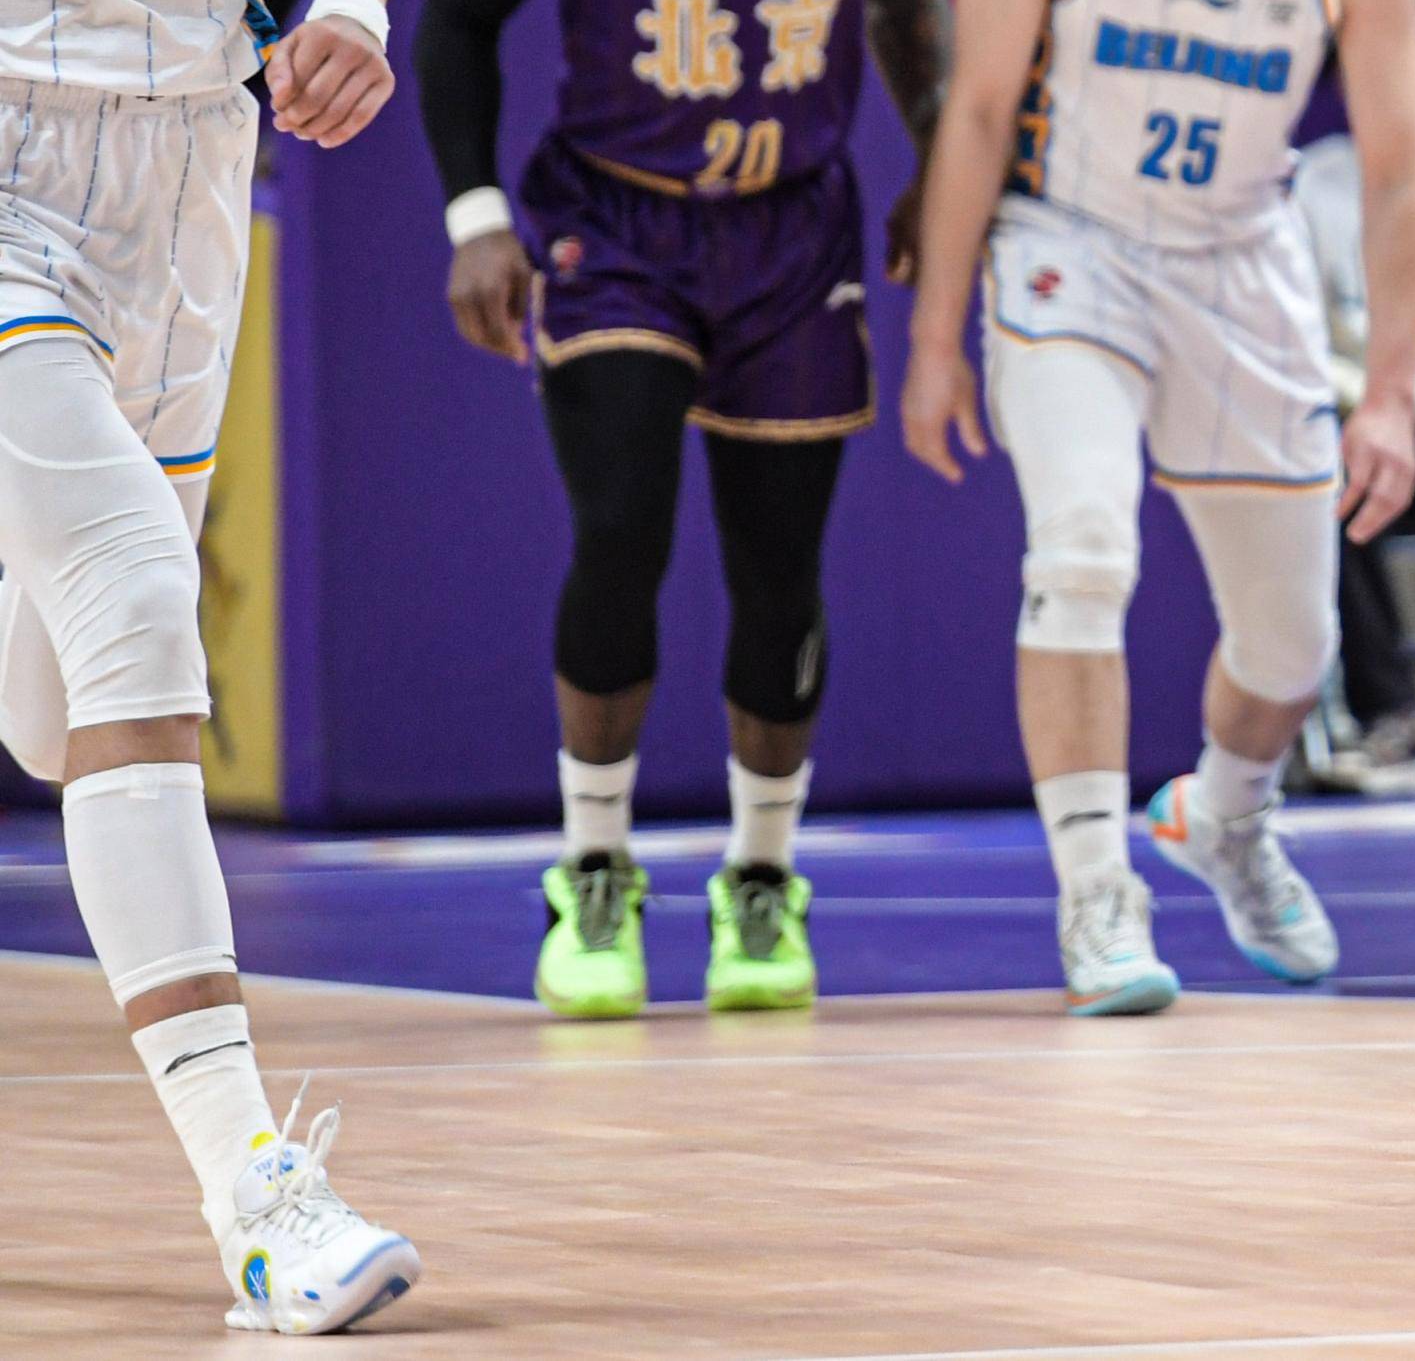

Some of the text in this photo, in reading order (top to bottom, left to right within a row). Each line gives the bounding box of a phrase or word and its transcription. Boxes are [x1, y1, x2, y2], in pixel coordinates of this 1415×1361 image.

[1094, 18, 1292, 95] BEIJING
[695, 118, 784, 194] 20
[1138, 109, 1222, 186] 25
